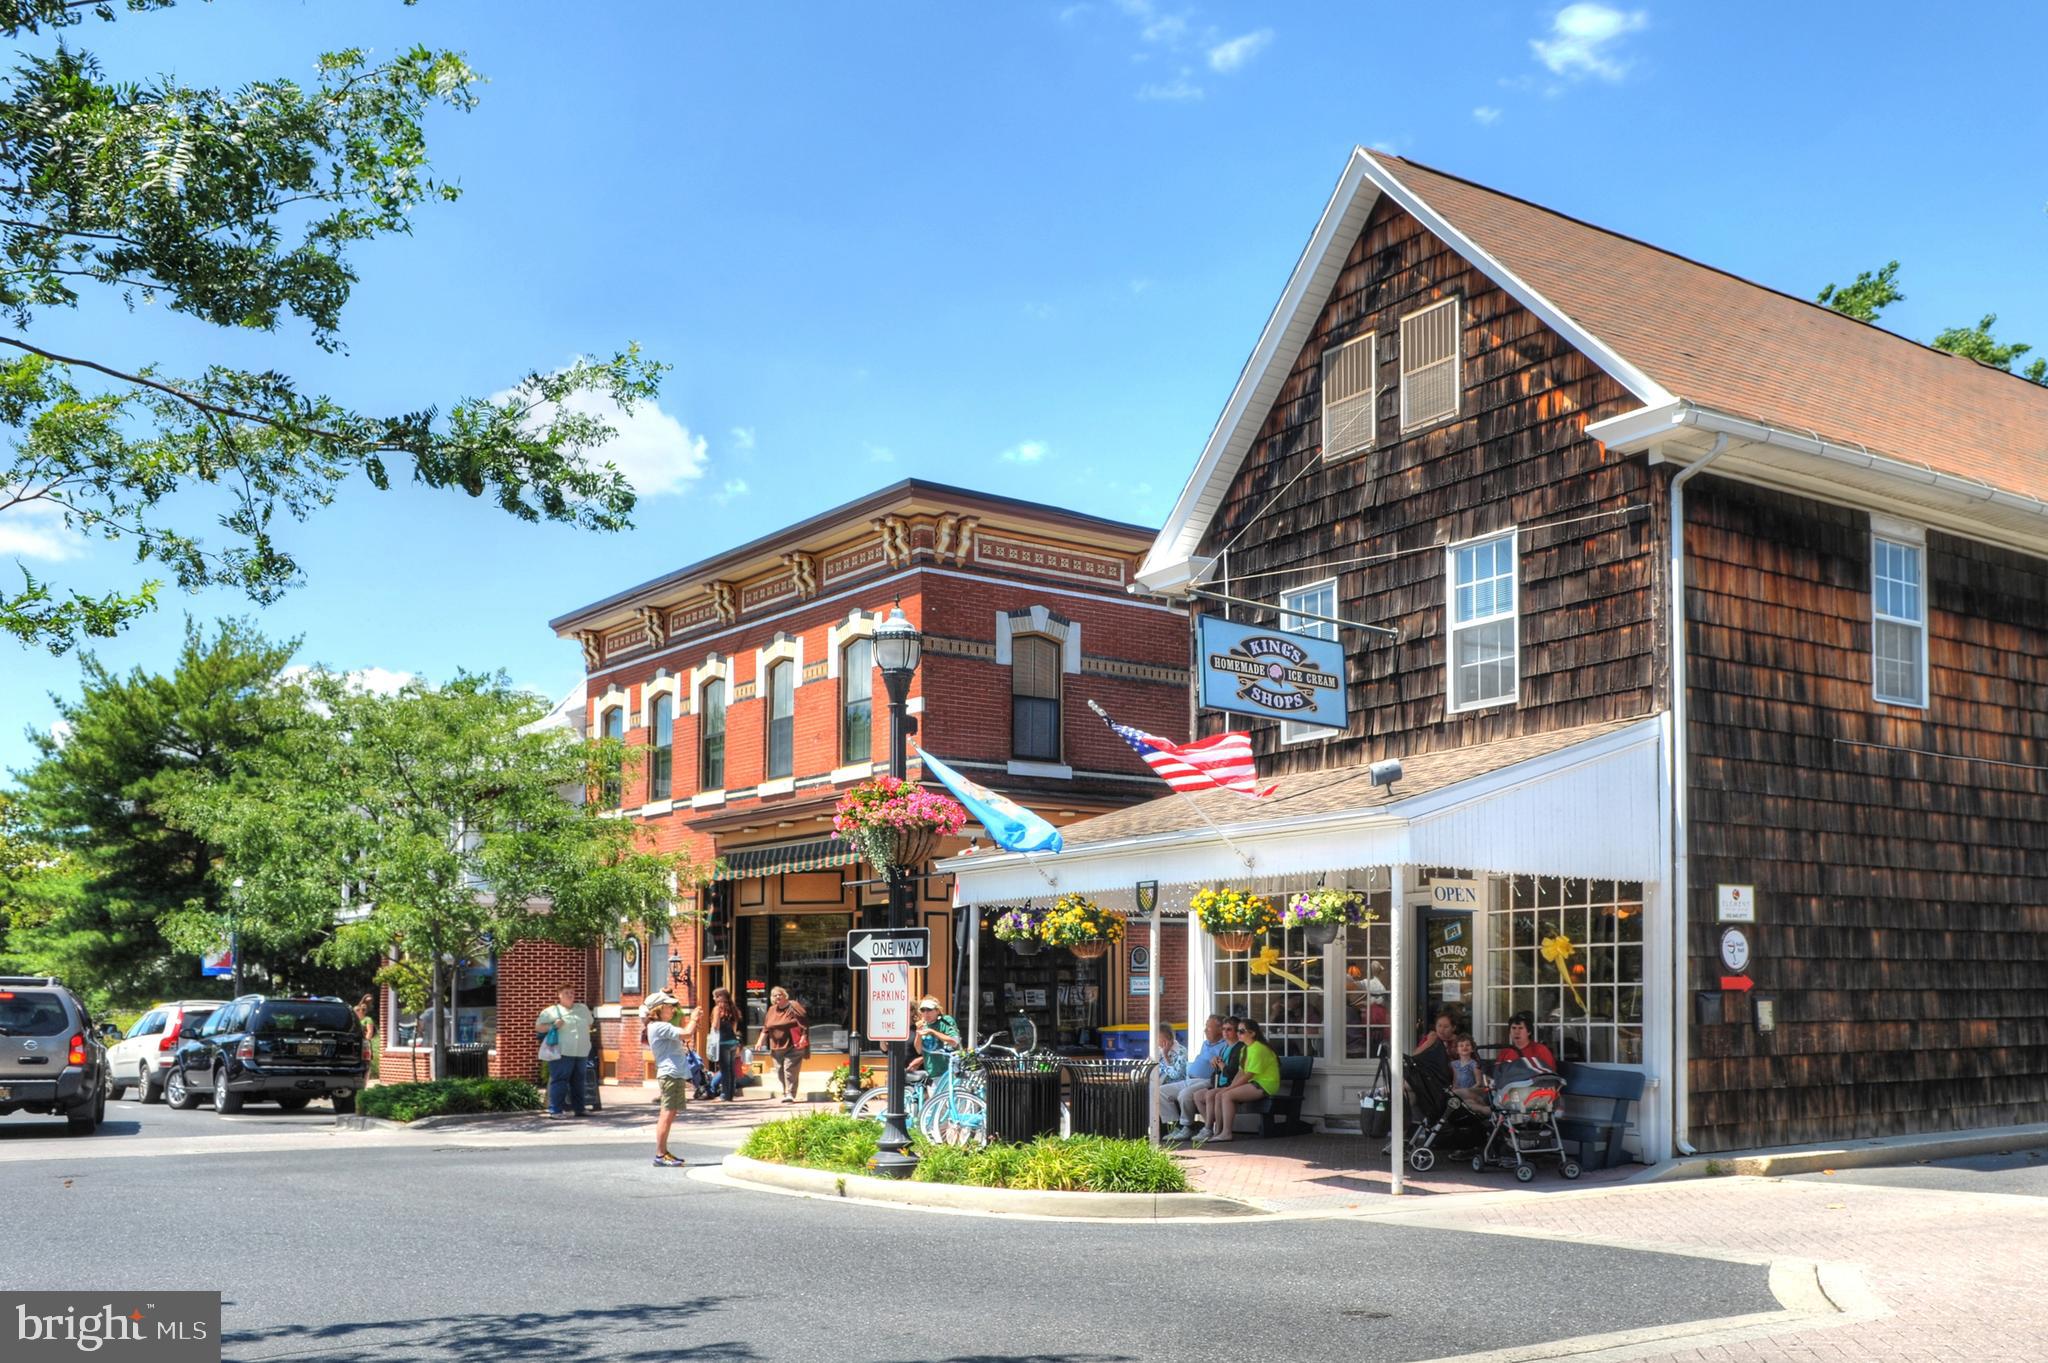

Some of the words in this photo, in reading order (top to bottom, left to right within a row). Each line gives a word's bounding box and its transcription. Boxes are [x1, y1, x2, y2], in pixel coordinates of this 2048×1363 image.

[1249, 639, 1301, 663] KING'S
[1213, 656, 1266, 676] HOMEMADE
[1287, 669, 1303, 682] ICE
[1306, 673, 1337, 688] CREAM
[1250, 687, 1304, 709] SHOPS
[1434, 886, 1476, 902] OPEN
[872, 942, 894, 956] ONE
[897, 940, 920, 955] WAY
[1434, 945, 1468, 957] KINGS
[1443, 962, 1458, 971] ICE
[882, 973, 895, 983] NO
[872, 990, 905, 1001] PARKING
[882, 1022, 895, 1030] TIME
